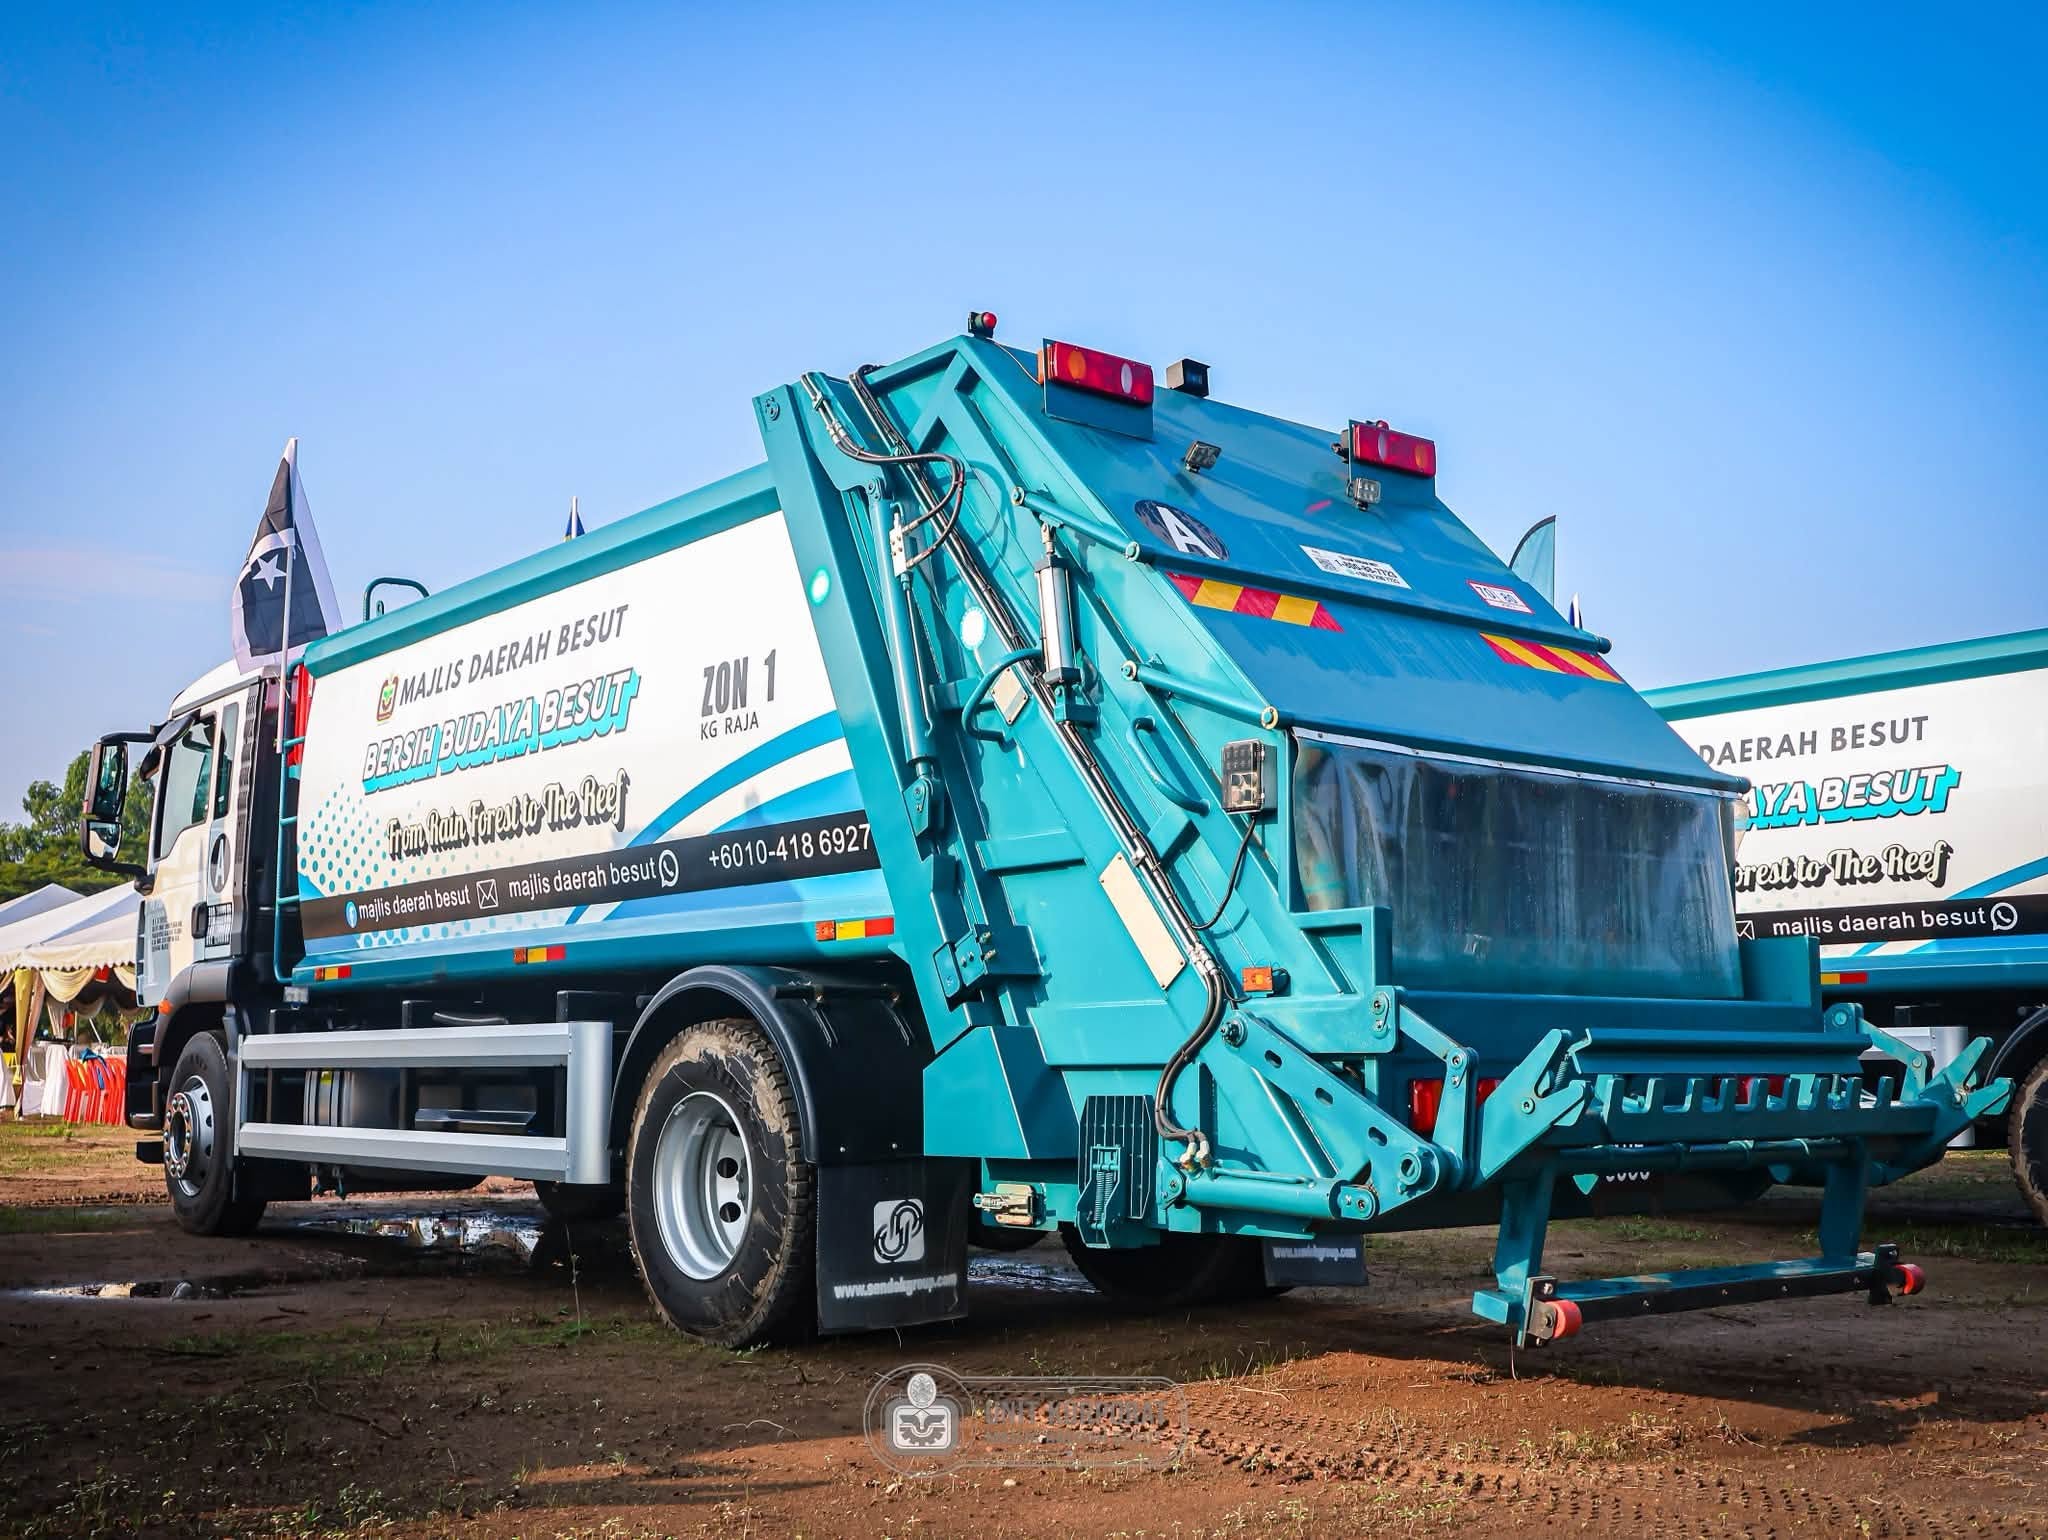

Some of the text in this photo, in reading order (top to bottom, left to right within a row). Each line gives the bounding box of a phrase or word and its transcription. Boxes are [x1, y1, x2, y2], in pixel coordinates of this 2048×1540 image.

[1156, 505, 1221, 560] A
[399, 604, 629, 706] MAJLIS DAERAH BESUT
[701, 648, 777, 718] ZON 1
[362, 668, 642, 795] BERSIH BUDAYA BESUT
[700, 711, 760, 741] KG RAJA
[1699, 715, 1929, 766] DAERAH BESUT
[386, 767, 631, 860] From Rain Forest to The Reef
[1741, 764, 1963, 832] AYA BESUT
[214, 837, 227, 889] A
[709, 823, 871, 869] +6010-418 6927
[1735, 839, 1954, 893] orest to The Reef
[358, 885, 471, 924] majlis daerah besut
[508, 857, 657, 900] majlis daerah besut
[1772, 906, 1987, 937] majlis daerah besut
